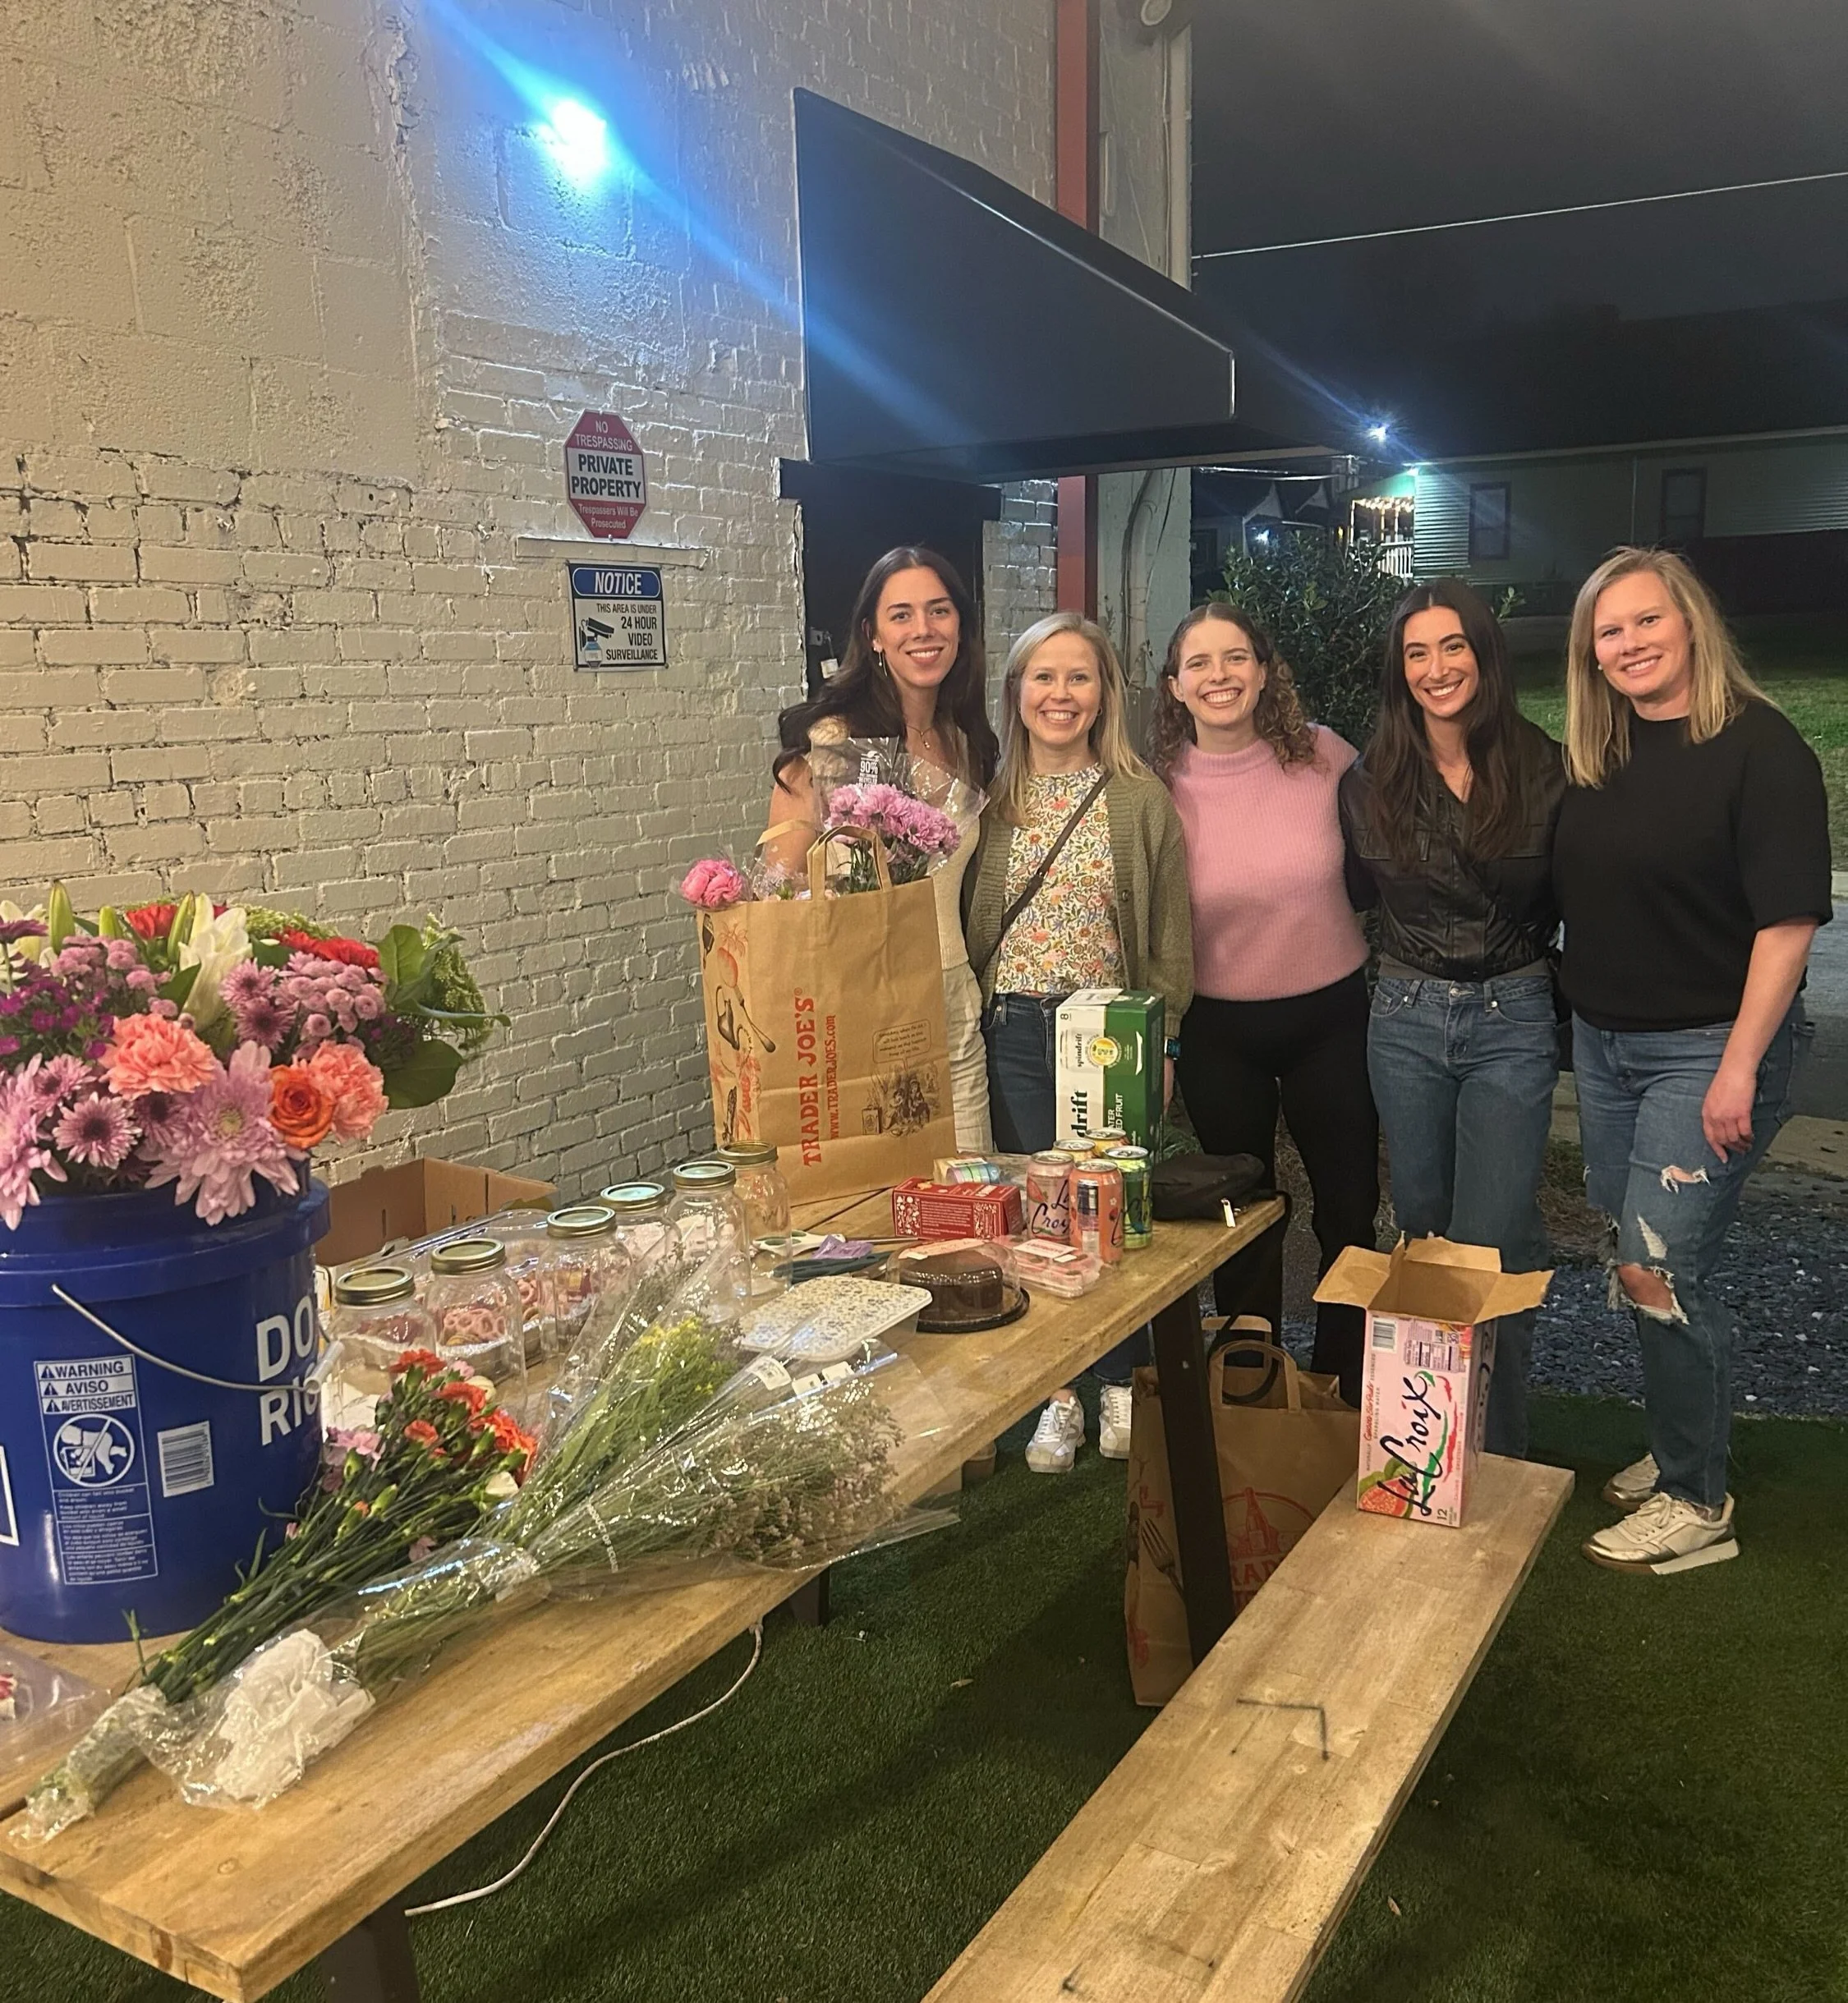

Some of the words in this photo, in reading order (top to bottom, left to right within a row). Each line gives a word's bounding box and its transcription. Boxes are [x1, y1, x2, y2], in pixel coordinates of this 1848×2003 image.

[595, 420, 609, 434] NO
[575, 434, 632, 452] TRESPASSING
[578, 453, 633, 476] PRIVATE
[571, 475, 641, 498] PROPERTY
[577, 503, 616, 517] Trespassers
[616, 505, 630, 517] Will
[630, 507, 638, 517] Be
[591, 517, 627, 531] Prosecuted
[594, 571, 642, 595] NOTICE
[596, 603, 612, 613] THIS
[612, 604, 630, 613] AREA
[630, 604, 637, 613] IS
[637, 604, 657, 614] UNDER
[620, 616, 633, 629] 24
[634, 616, 657, 630] HOUR
[627, 632, 653, 646] VIDEO
[605, 648, 658, 661] SURVEILLANCE
[795, 997, 818, 1068] JOE'S
[1075, 1033, 1084, 1068] spindrift
[825, 1014, 839, 1141] www.TRADERJOES.com
[1115, 1093, 1124, 1117] FRUIT
[798, 1073, 822, 1167] TRADER
[255, 1295, 314, 1383] DO
[54, 1360, 124, 1379] WARNING
[65, 1380, 109, 1395] AVISO
[61, 1394, 134, 1413] AVERTISSEMENT
[1437, 1508, 1448, 1521] 12
